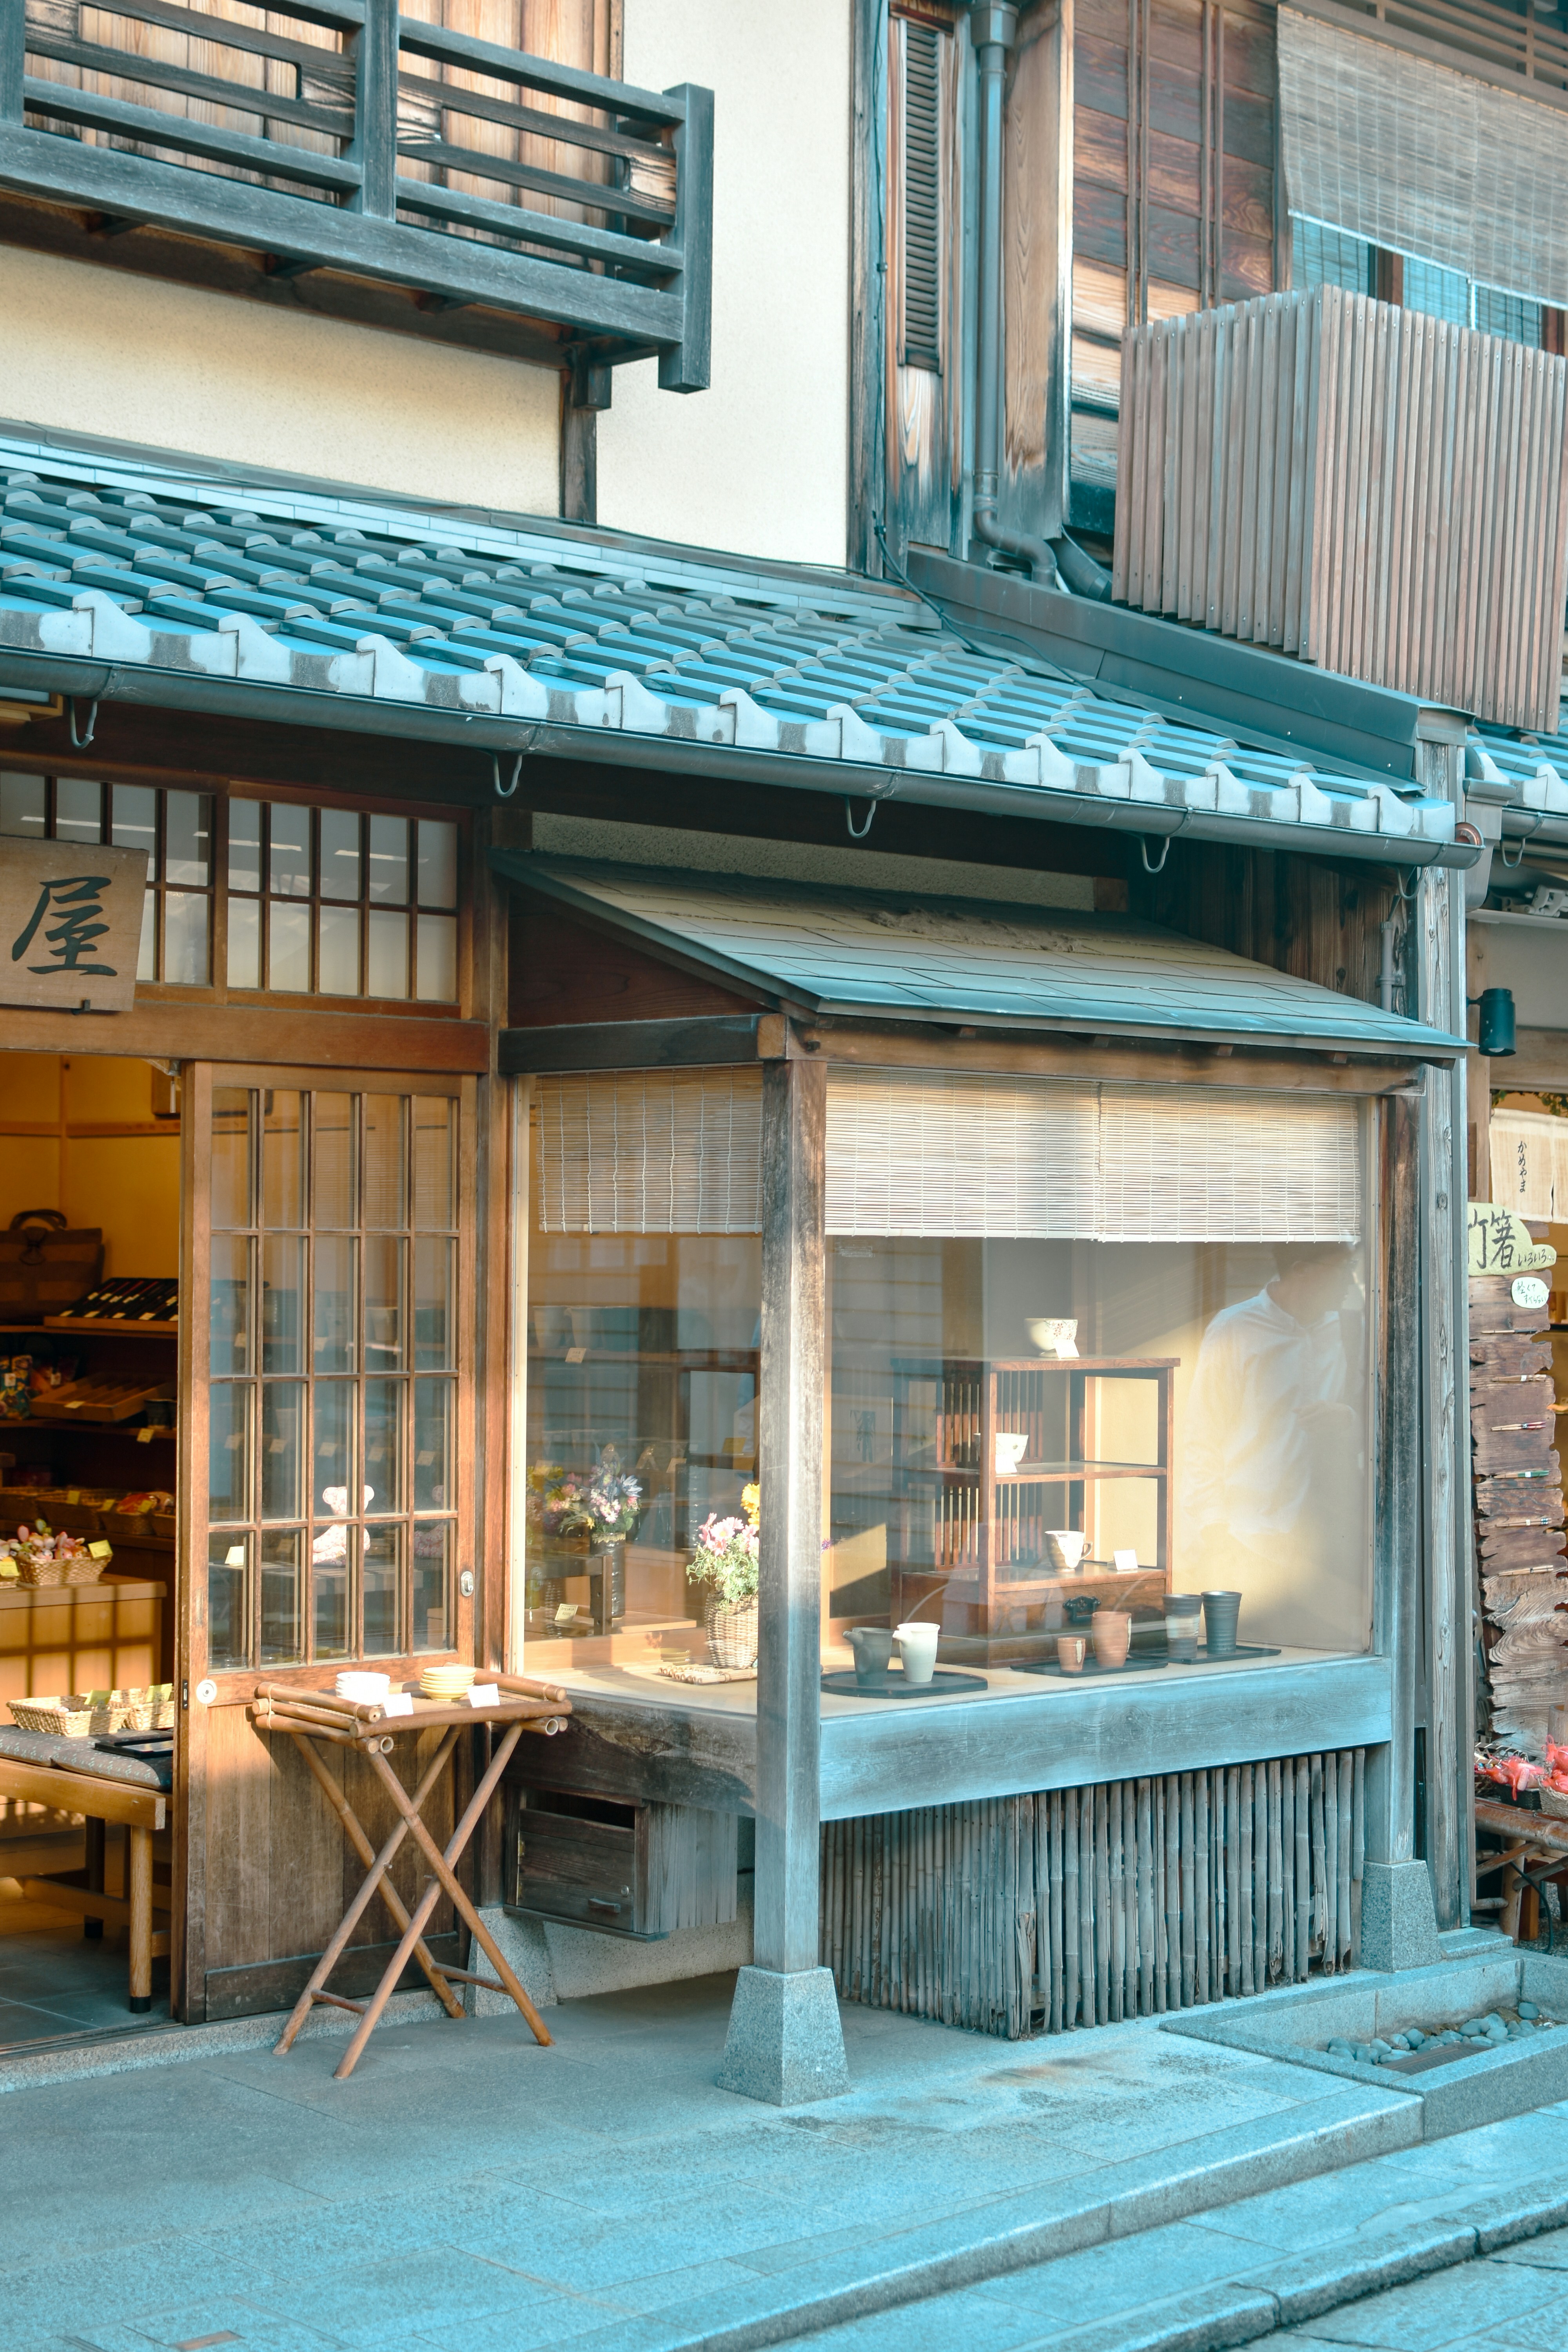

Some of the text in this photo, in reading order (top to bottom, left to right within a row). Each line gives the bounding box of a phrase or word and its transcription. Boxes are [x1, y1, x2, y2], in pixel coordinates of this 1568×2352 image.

[12, 877, 117, 976] 屋
[1518, 1141, 1527, 1192] かめやま
